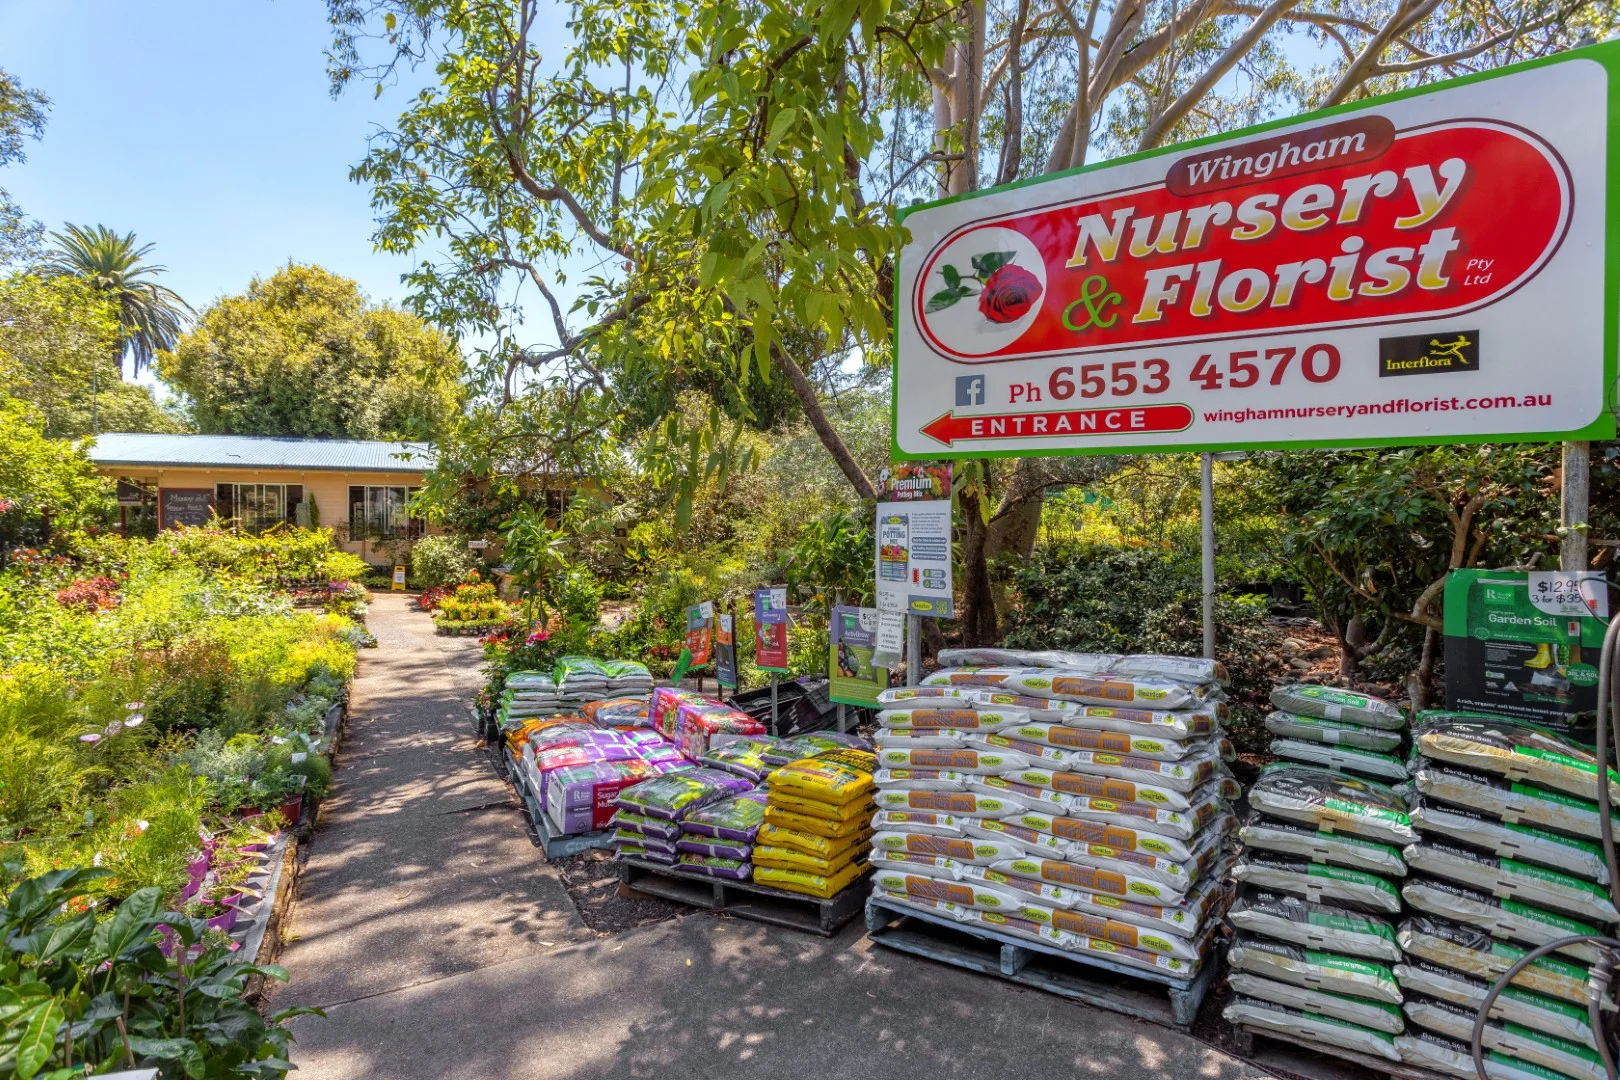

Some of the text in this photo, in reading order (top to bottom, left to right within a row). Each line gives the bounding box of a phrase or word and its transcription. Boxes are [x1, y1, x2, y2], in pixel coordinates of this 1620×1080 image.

[1187, 127, 1366, 188] Wingham
[1065, 158, 1469, 268] Nursery
[1466, 257, 1494, 275] Pty
[1062, 227, 1463, 332] & Florist
[1464, 272, 1491, 288] Ltd
[1386, 353, 1453, 371] Interflora
[1009, 343, 1341, 404] Ph 6553 4570
[1204, 394, 1553, 423] winghamnurseryandflorist.com.au
[971, 410, 1147, 436] ENTRANCE
[891, 476, 932, 490] Premium
[883, 530, 906, 538] POTTING
[1532, 595, 1540, 603] 3
[1542, 595, 1553, 603] for
[1488, 614, 1558, 627] Garden Soil
[1023, 679, 1050, 687] Searles
[1137, 687, 1163, 698] Searles
[1323, 693, 1360, 706] Garden Soil
[1021, 728, 1046, 738] Searles
[1103, 739, 1125, 751] MIX
[1135, 742, 1160, 751] Searles
[1542, 753, 1560, 762] Good
[1570, 760, 1591, 769] grow
[1443, 767, 1488, 783] Garden Soil
[1024, 773, 1166, 801] Searles POTTING MIX Searles
[597, 792, 618, 800] Sugar
[1436, 806, 1481, 819] Garden Soil
[1024, 817, 1047, 828] Searles
[1108, 833, 1130, 846] MIX
[1261, 821, 1297, 832] Garden Soil
[1531, 828, 1549, 837] Good
[1560, 837, 1579, 845] grow
[1432, 843, 1477, 859] Garden Soil
[1255, 859, 1277, 868] Garden
[1013, 862, 1035, 872] Searles
[1097, 877, 1120, 891] MIX
[1131, 883, 1157, 897] Searles
[1329, 870, 1344, 878] Good
[1352, 874, 1366, 882] grow
[1527, 868, 1545, 877] Good
[1555, 876, 1575, 884] grow
[1434, 882, 1478, 898] Garden Soil
[1254, 904, 1290, 917] Garden Soil
[1528, 910, 1546, 919] Good
[1556, 920, 1575, 929] grow
[1024, 910, 1047, 921] Searles
[1108, 927, 1131, 941] MIX
[1142, 936, 1169, 951] Searles
[1425, 927, 1453, 939] Garden
[1250, 941, 1274, 951] Garden
[1420, 962, 1465, 980] Garden Soil
[1436, 1002, 1463, 1015] Garden
[1516, 991, 1535, 1002] Good
[1545, 999, 1564, 1011] grow
[1422, 1032, 1450, 1046] Garden
[1532, 1032, 1551, 1042] Good
[1560, 1041, 1580, 1052] grow
[1517, 1061, 1535, 1072] Good
[1545, 1070, 1565, 1080] grow
